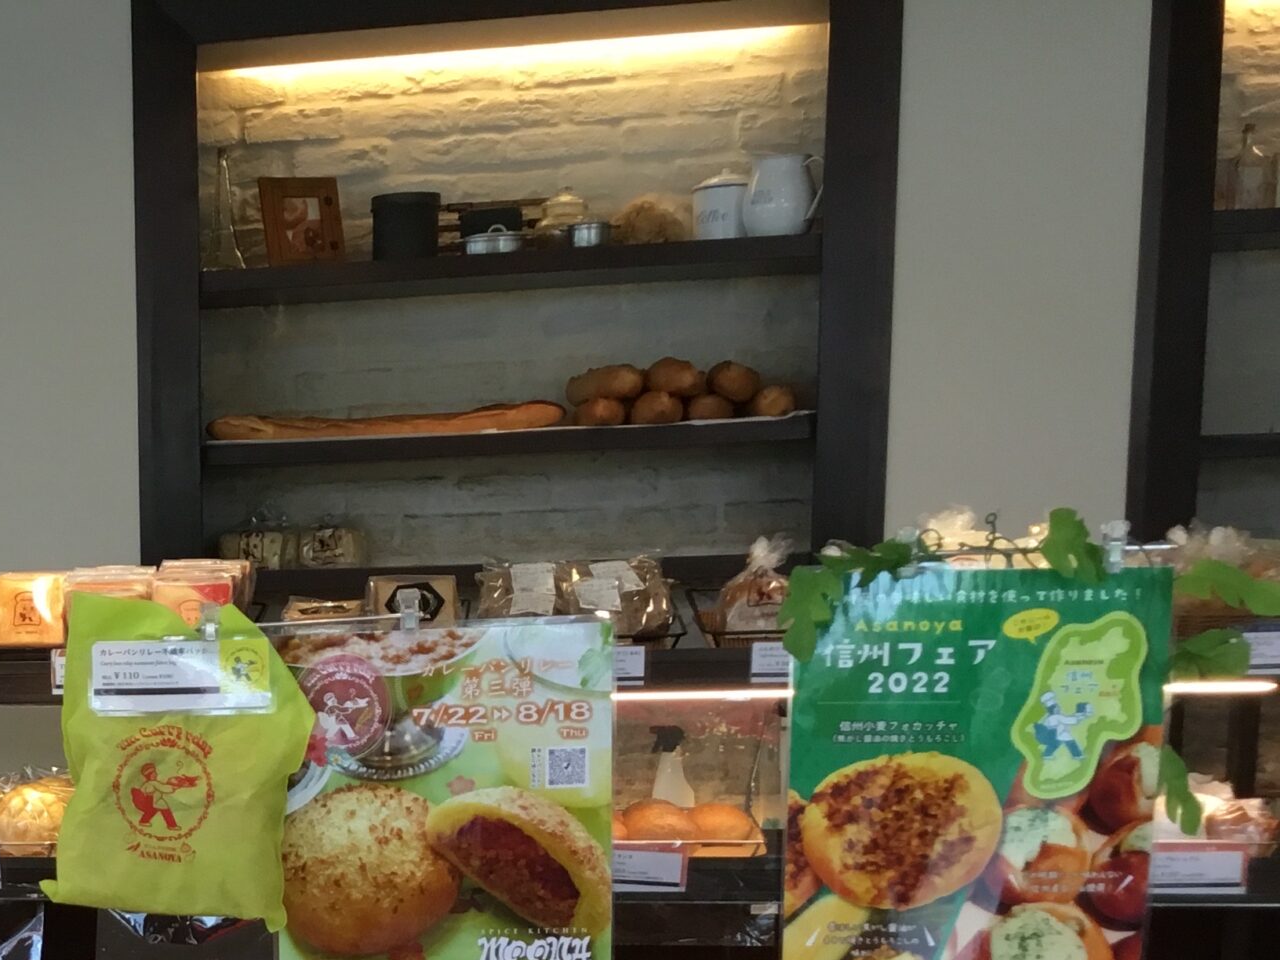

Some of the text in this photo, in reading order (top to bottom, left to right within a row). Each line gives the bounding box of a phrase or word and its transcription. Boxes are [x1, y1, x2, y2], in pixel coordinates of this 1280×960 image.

[854, 618, 964, 634] Asanoya
[823, 638, 997, 669] 信州フェア
[420, 658, 572, 678] カレーパンリレー
[462, 677, 533, 698] 第三弾
[867, 671, 951, 694] 2022
[412, 701, 592, 728] 7/22 8/18
[473, 727, 588, 741] Fri Thu
